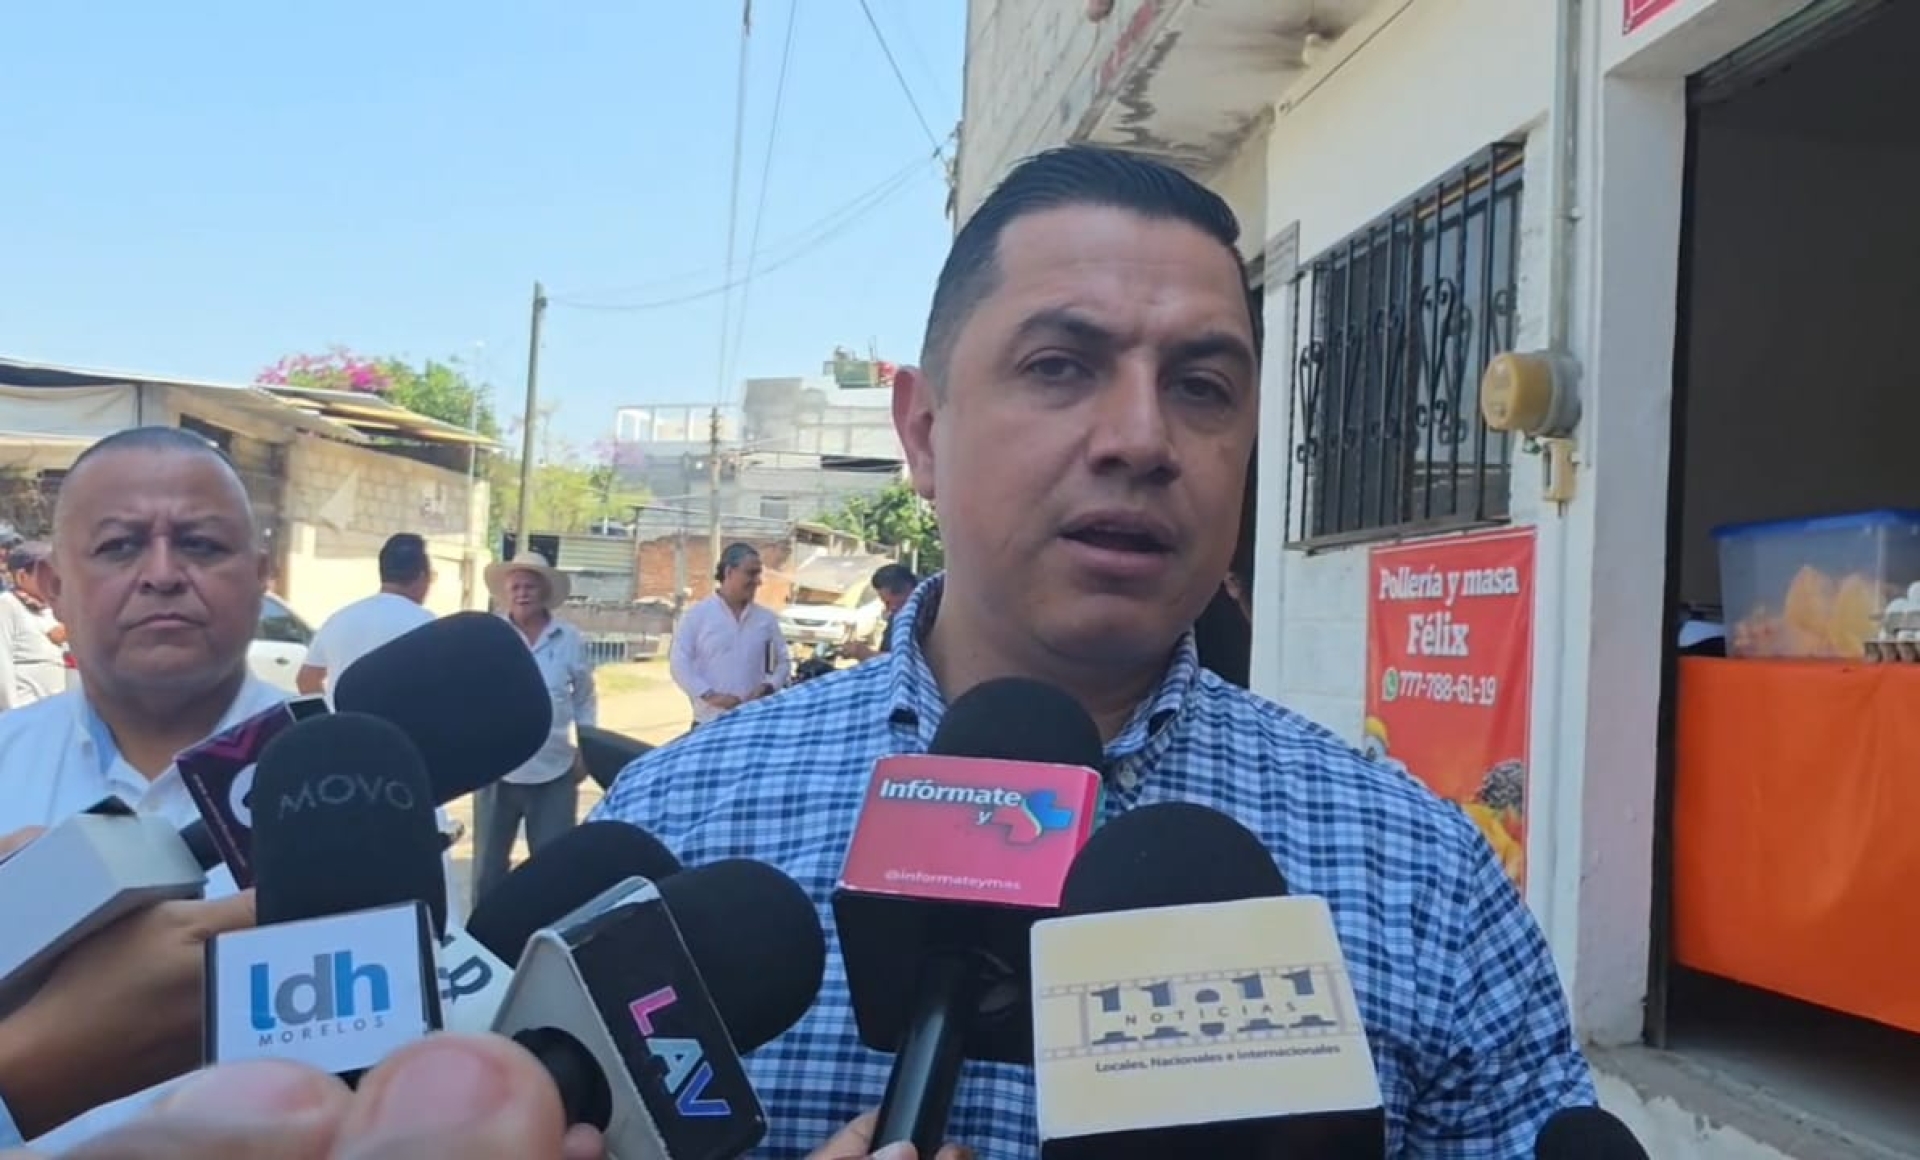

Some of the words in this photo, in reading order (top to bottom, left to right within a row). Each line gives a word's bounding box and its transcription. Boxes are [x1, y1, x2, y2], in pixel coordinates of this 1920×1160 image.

[1379, 564, 1443, 600] Pollería
[1445, 571, 1460, 606] y
[1461, 567, 1519, 595] masa
[1406, 612, 1470, 656] Félix
[1400, 670, 1497, 705] 777-788-61-19
[279, 775, 414, 819] MOVO
[880, 779, 1022, 807] Infórmate
[976, 811, 993, 825] y
[1125, 1002, 1297, 1026] NOTICIAS
[258, 1017, 385, 1046] MORELOS
[629, 985, 731, 1116] LAV
[1151, 1052, 1223, 1068] Nacionales
[1237, 1043, 1341, 1060] Internacionales
